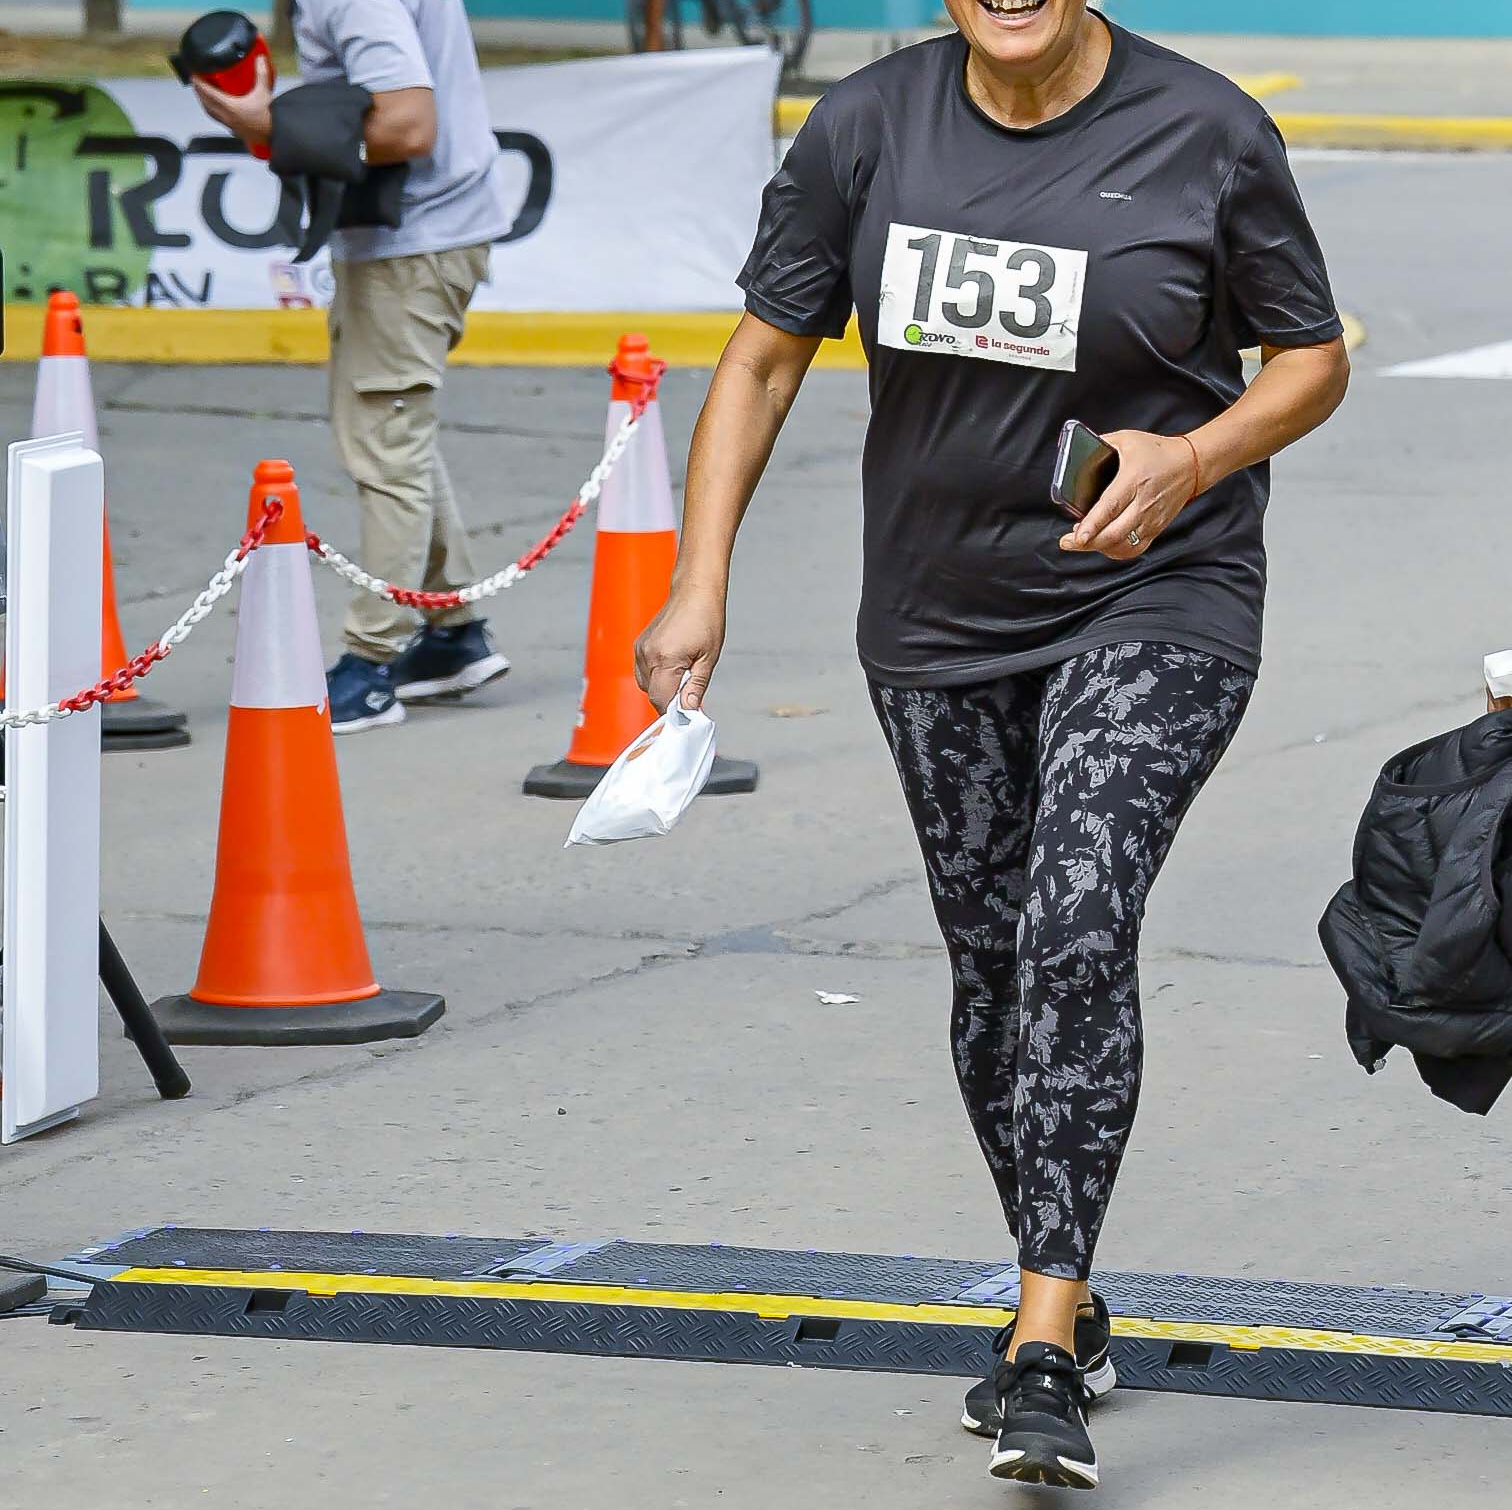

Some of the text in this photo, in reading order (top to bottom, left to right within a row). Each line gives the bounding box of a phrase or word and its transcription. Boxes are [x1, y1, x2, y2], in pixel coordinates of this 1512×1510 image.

[907, 233, 1056, 338] 153
[992, 338, 1050, 356] la segunda
